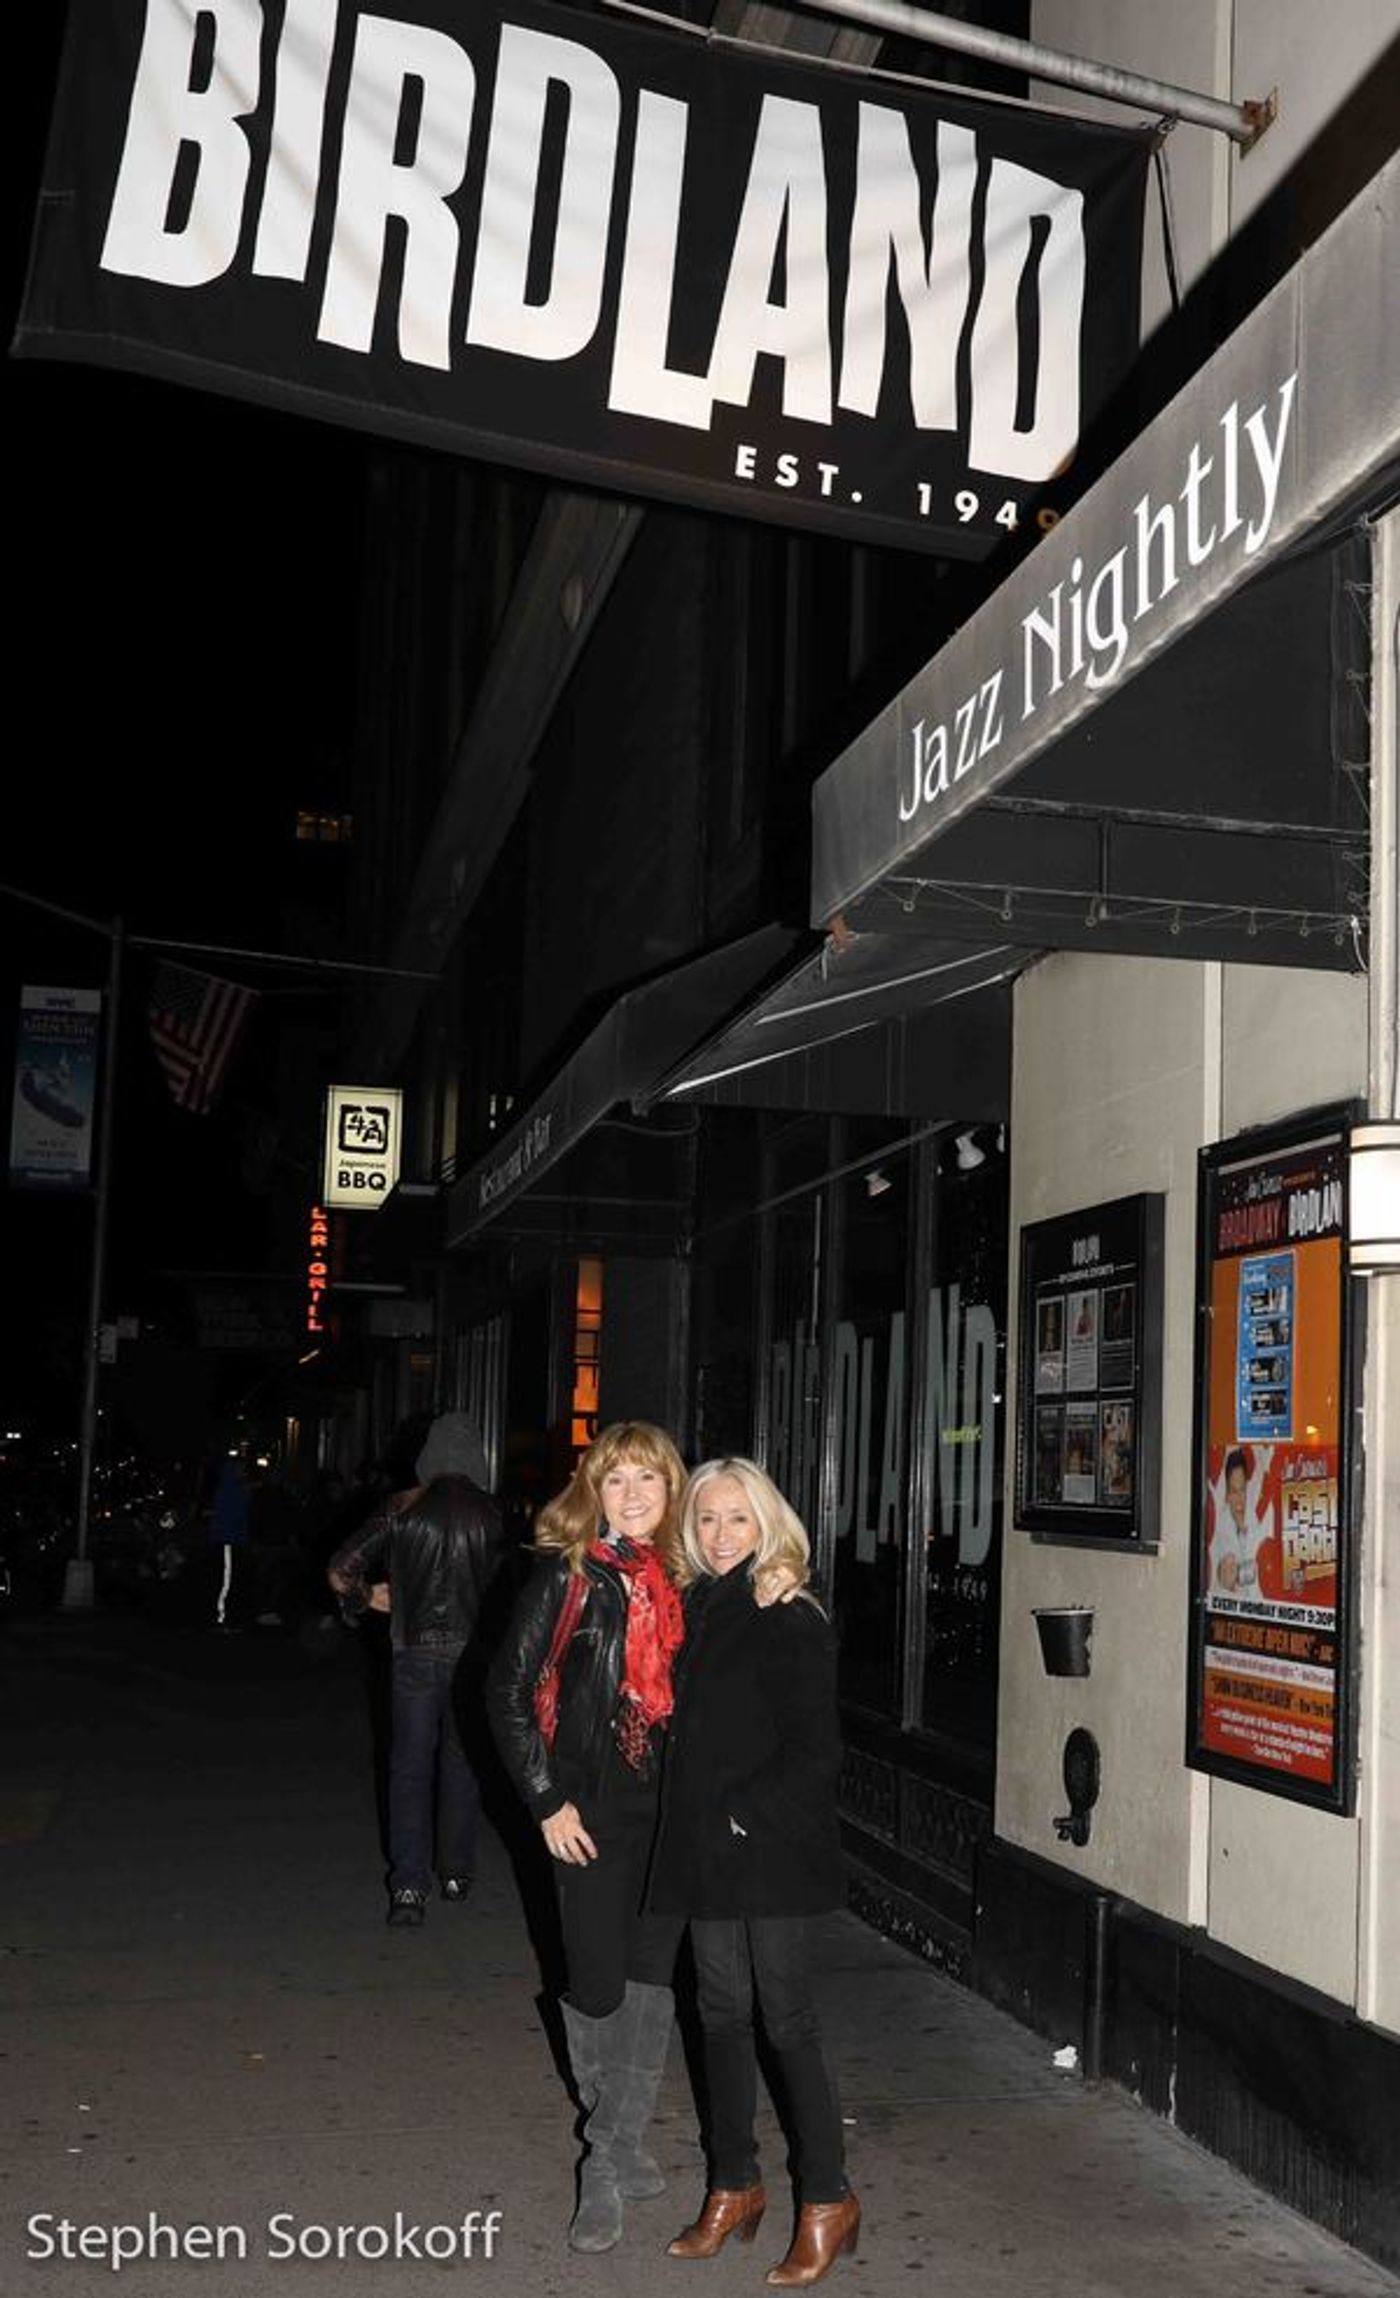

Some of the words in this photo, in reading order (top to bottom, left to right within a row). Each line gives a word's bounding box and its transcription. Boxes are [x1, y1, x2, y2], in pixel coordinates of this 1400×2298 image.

[100, 0, 1084, 482] BIRDLAND
[735, 444, 863, 504] EST.
[899, 671, 1003, 822] Jazz
[1021, 371, 1297, 720] Nightly
[337, 1172, 387, 1191] BBQ
[338, 1158, 387, 1169] Japanese
[1211, 1596, 1238, 1610] EVERY
[1239, 1600, 1275, 1618] MONDAY
[1278, 1604, 1305, 1622] NIGHT
